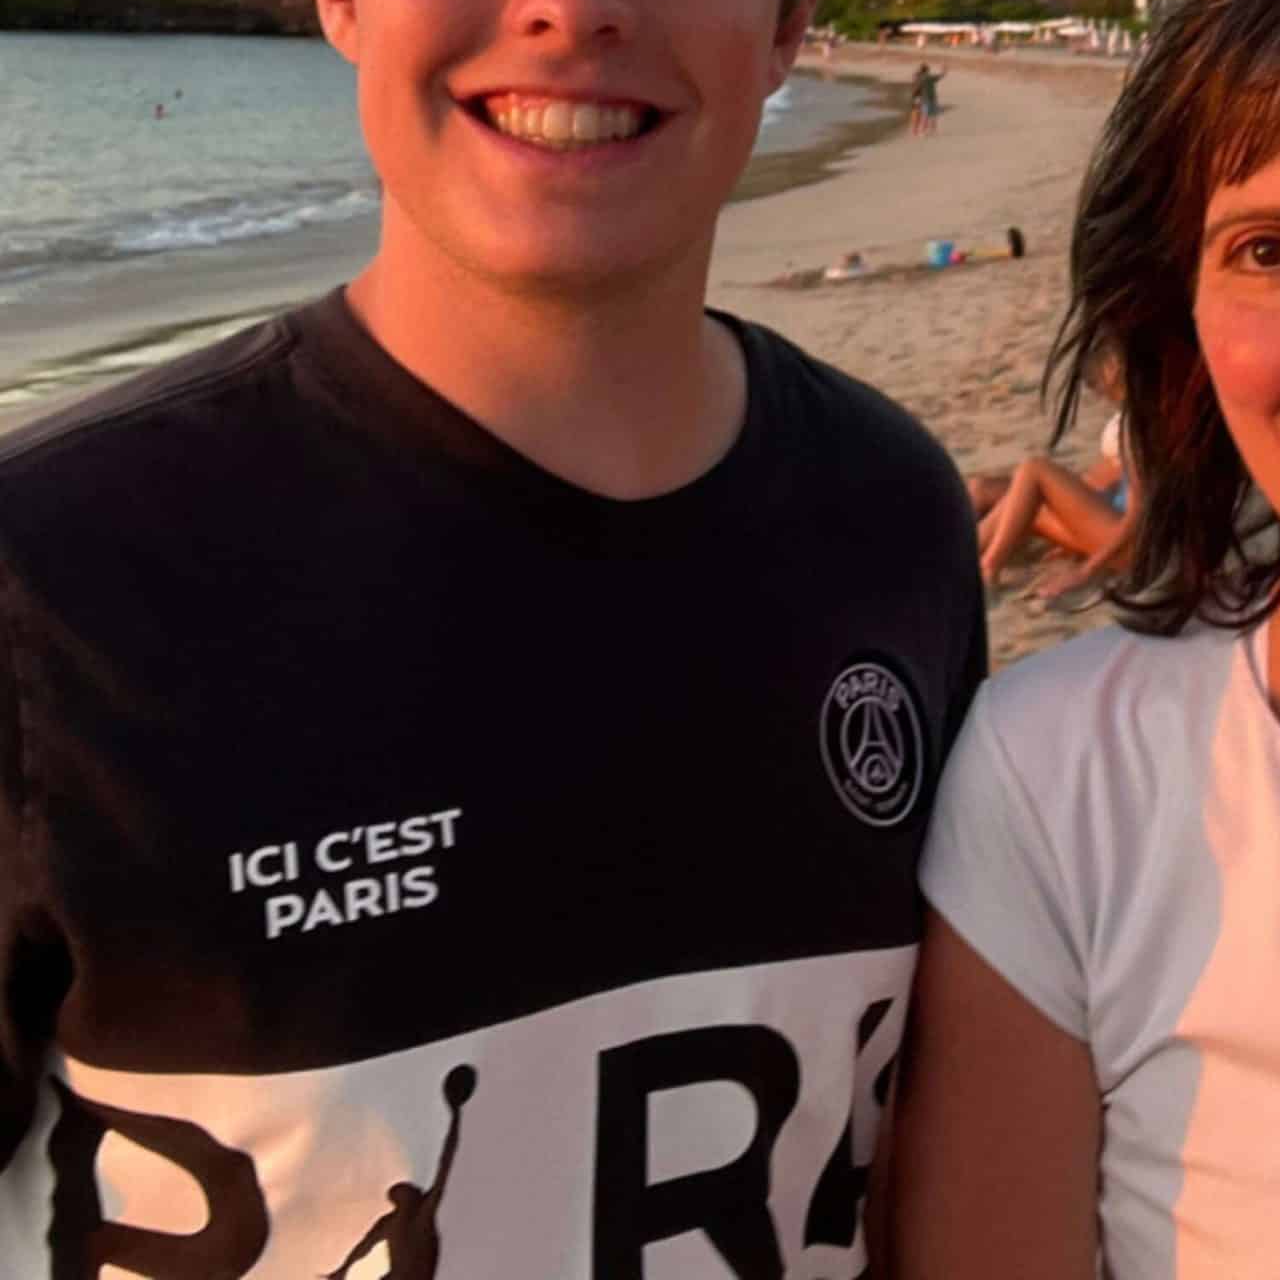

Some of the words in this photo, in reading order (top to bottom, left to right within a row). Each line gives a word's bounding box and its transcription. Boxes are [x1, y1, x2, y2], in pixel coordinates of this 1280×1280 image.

[834, 671, 901, 711] PARIS
[228, 841, 299, 893] ICI
[314, 807, 463, 873] C'EST
[264, 865, 439, 939] PARIS
